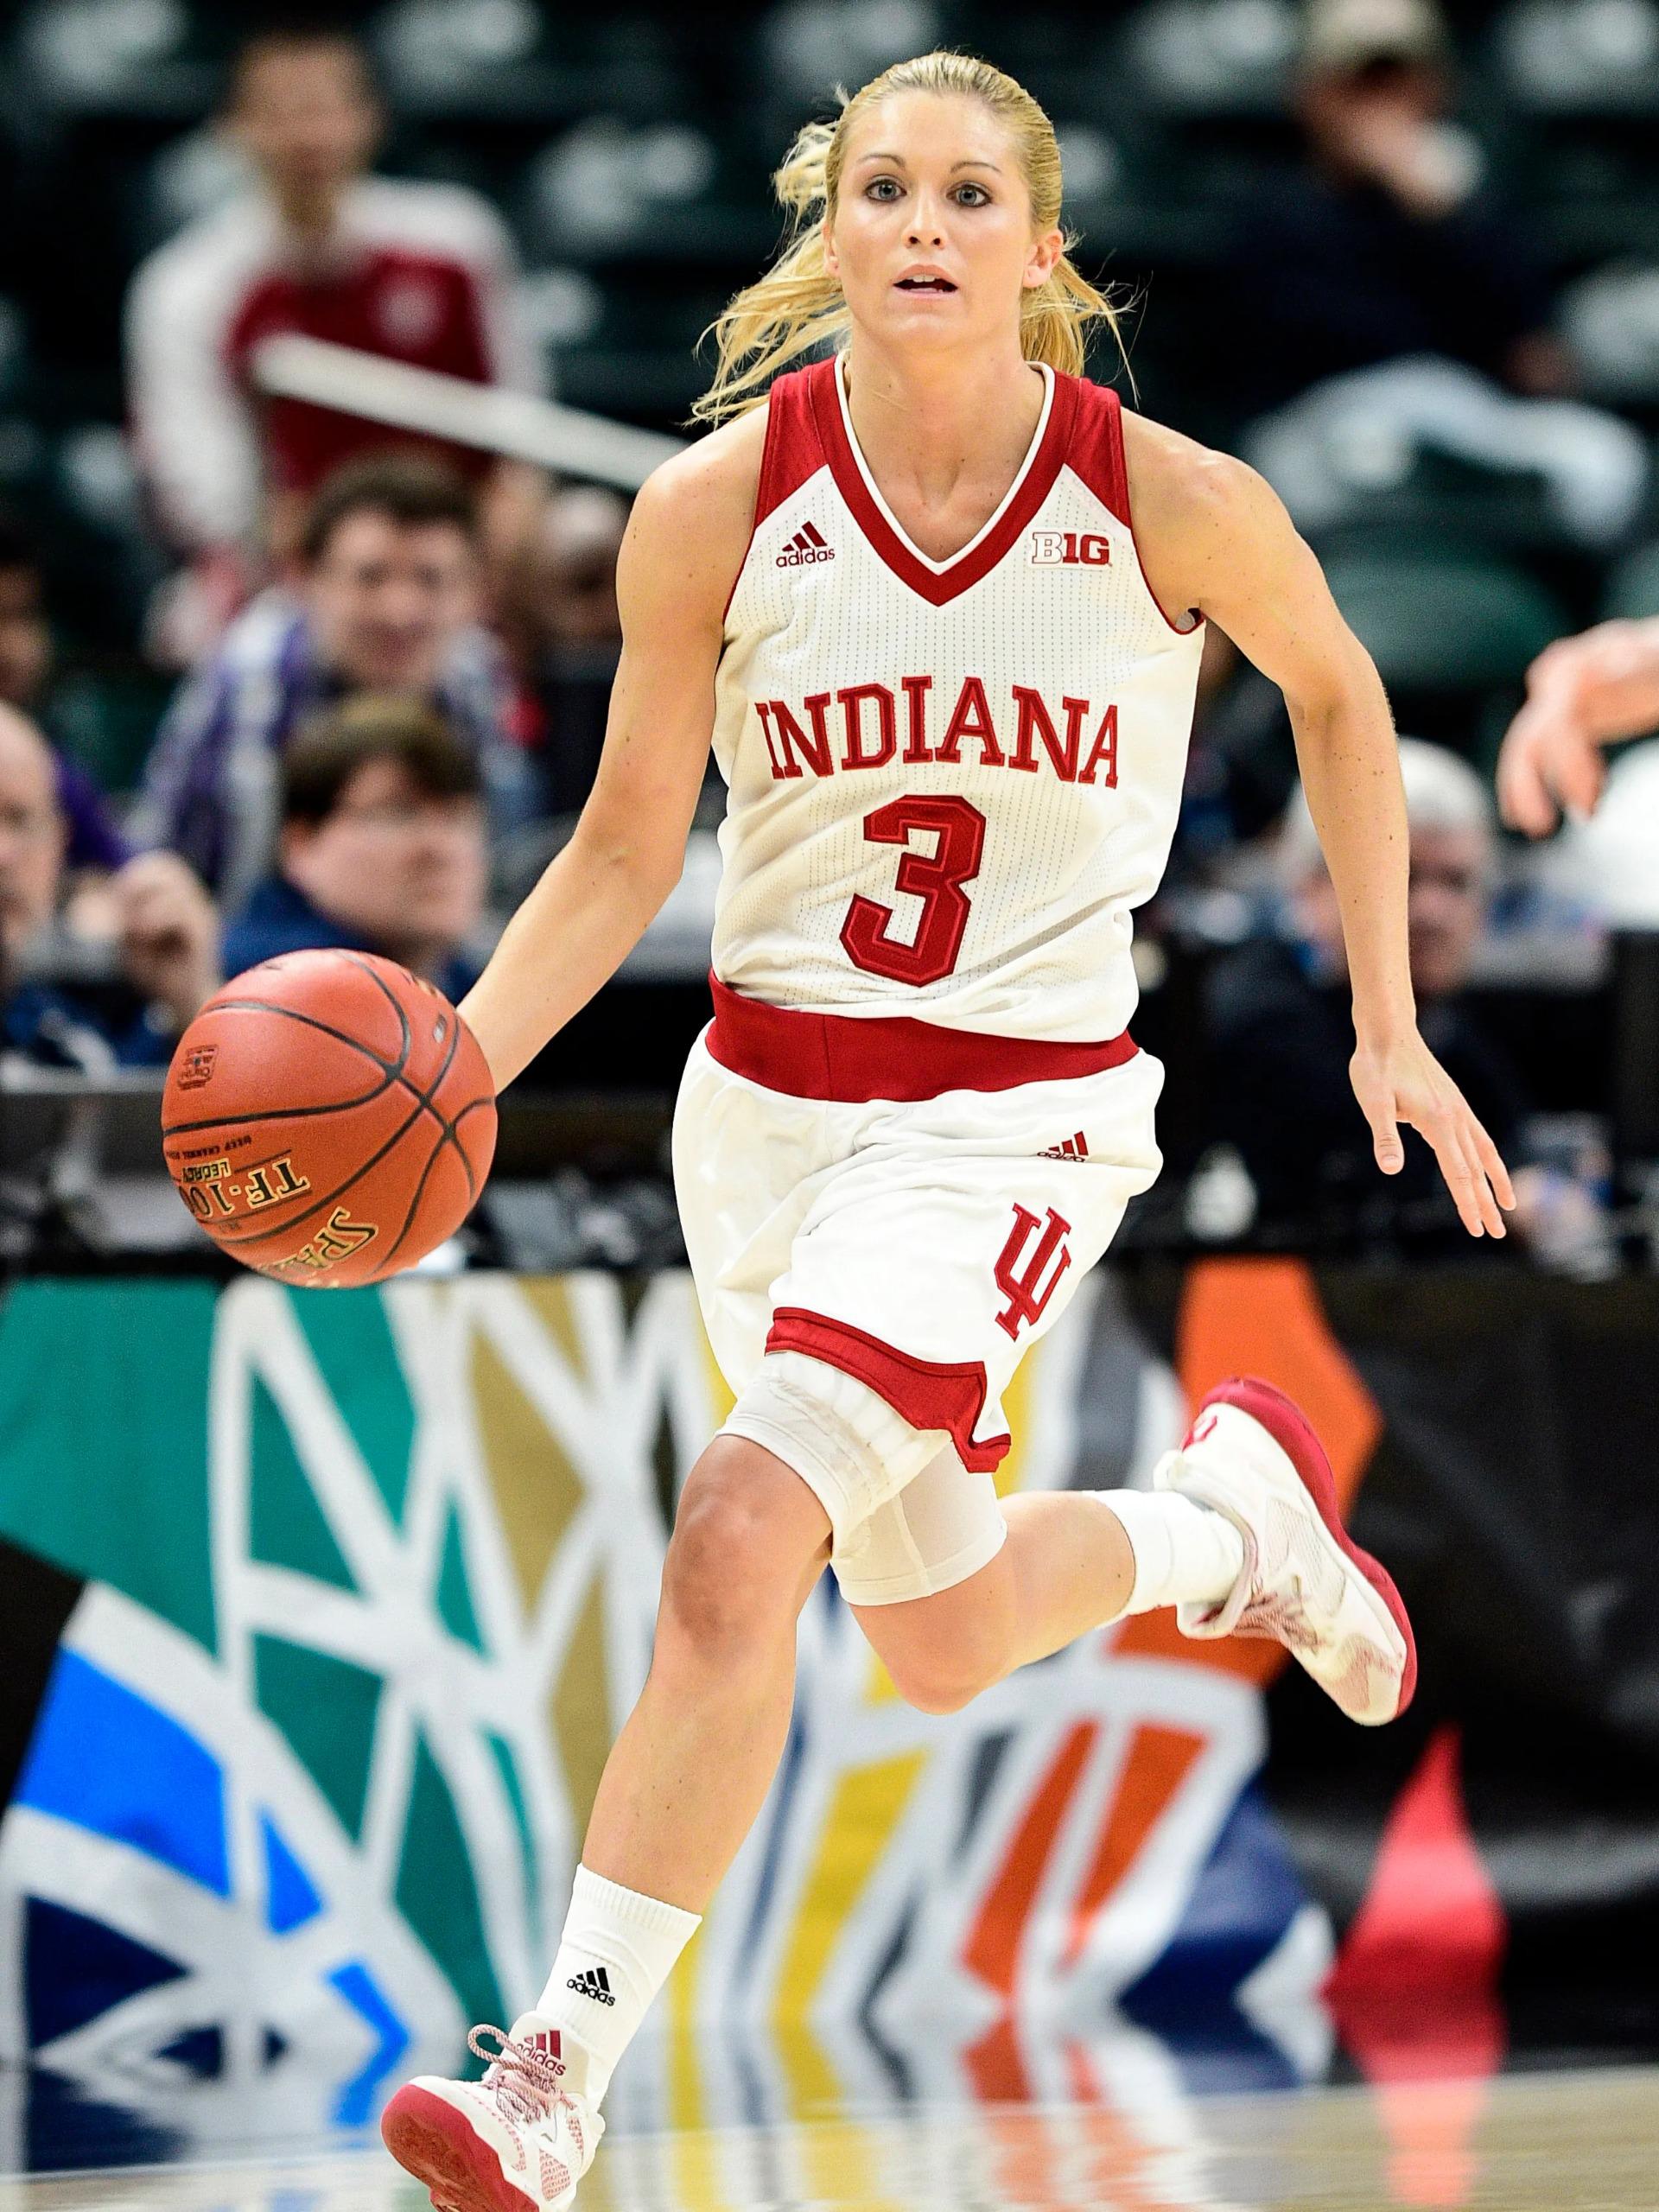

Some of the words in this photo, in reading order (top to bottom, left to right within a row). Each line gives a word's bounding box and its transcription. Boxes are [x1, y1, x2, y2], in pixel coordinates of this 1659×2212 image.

[775, 548, 836, 568] adidas
[754, 675, 1118, 789] INDIANA
[839, 794, 987, 987] 3
[566, 1974, 616, 2006] adidas
